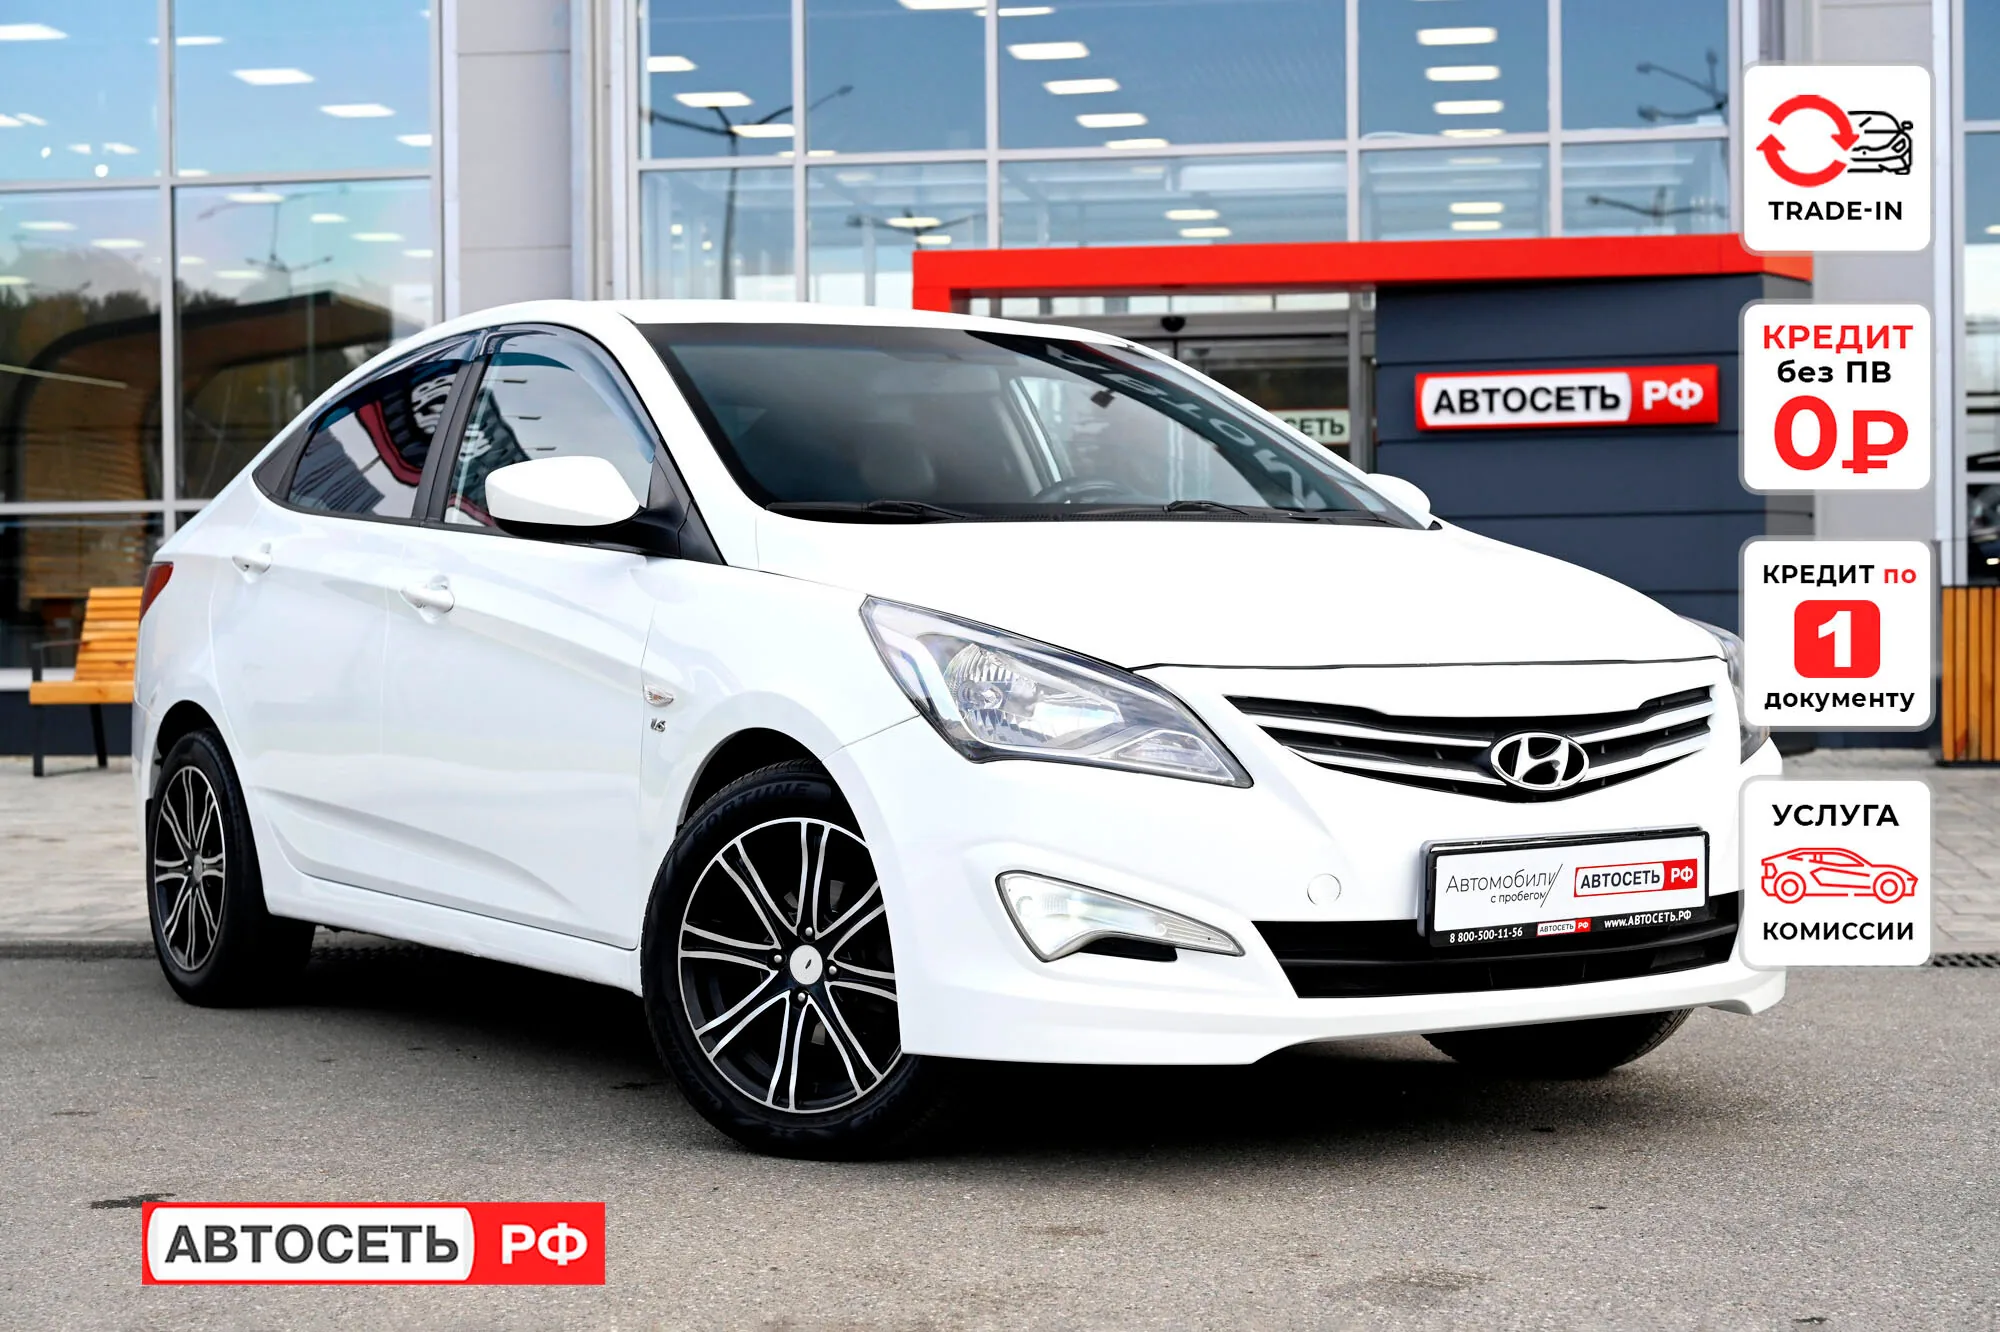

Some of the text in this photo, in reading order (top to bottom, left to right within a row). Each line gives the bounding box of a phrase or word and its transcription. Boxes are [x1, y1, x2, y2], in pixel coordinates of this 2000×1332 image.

[1433, 377, 1704, 416] АВТОСЕТЬ РФ
[1580, 866, 1694, 889] АВТОСЕТЬ РФ
[1490, 895, 1497, 904] с
[1539, 921, 1589, 933] АВТОСЕТЬ РФ
[1604, 909, 1692, 928] www.АВТОСЕТЬ.РФ
[1449, 927, 1523, 943] 8 800-500-11-56
